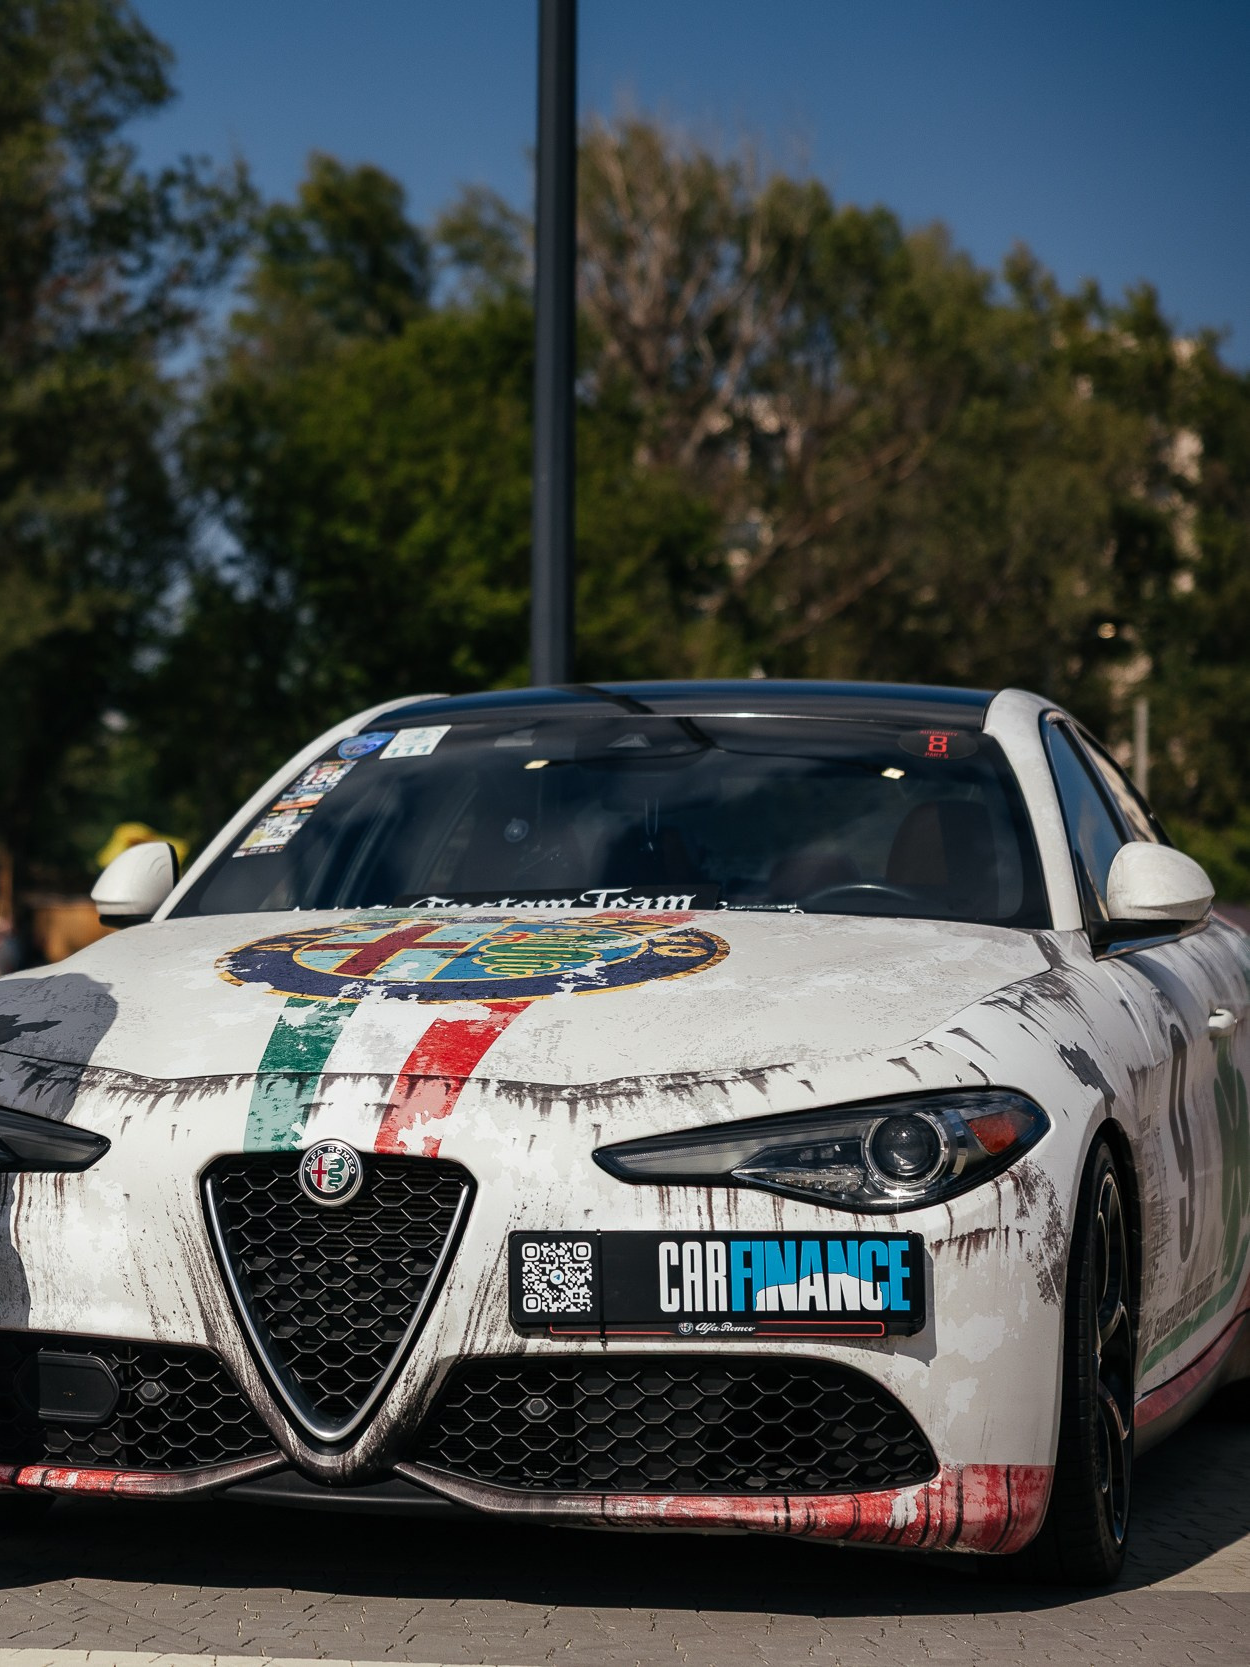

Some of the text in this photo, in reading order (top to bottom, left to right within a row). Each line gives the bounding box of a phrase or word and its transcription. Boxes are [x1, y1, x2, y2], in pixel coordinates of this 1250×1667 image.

[928, 736, 947, 752] 8
[305, 1146, 356, 1174] ALFA ROMEO
[659, 1240, 910, 1312] CARFINANCE
[695, 1322, 755, 1334] Alfa Romeo
